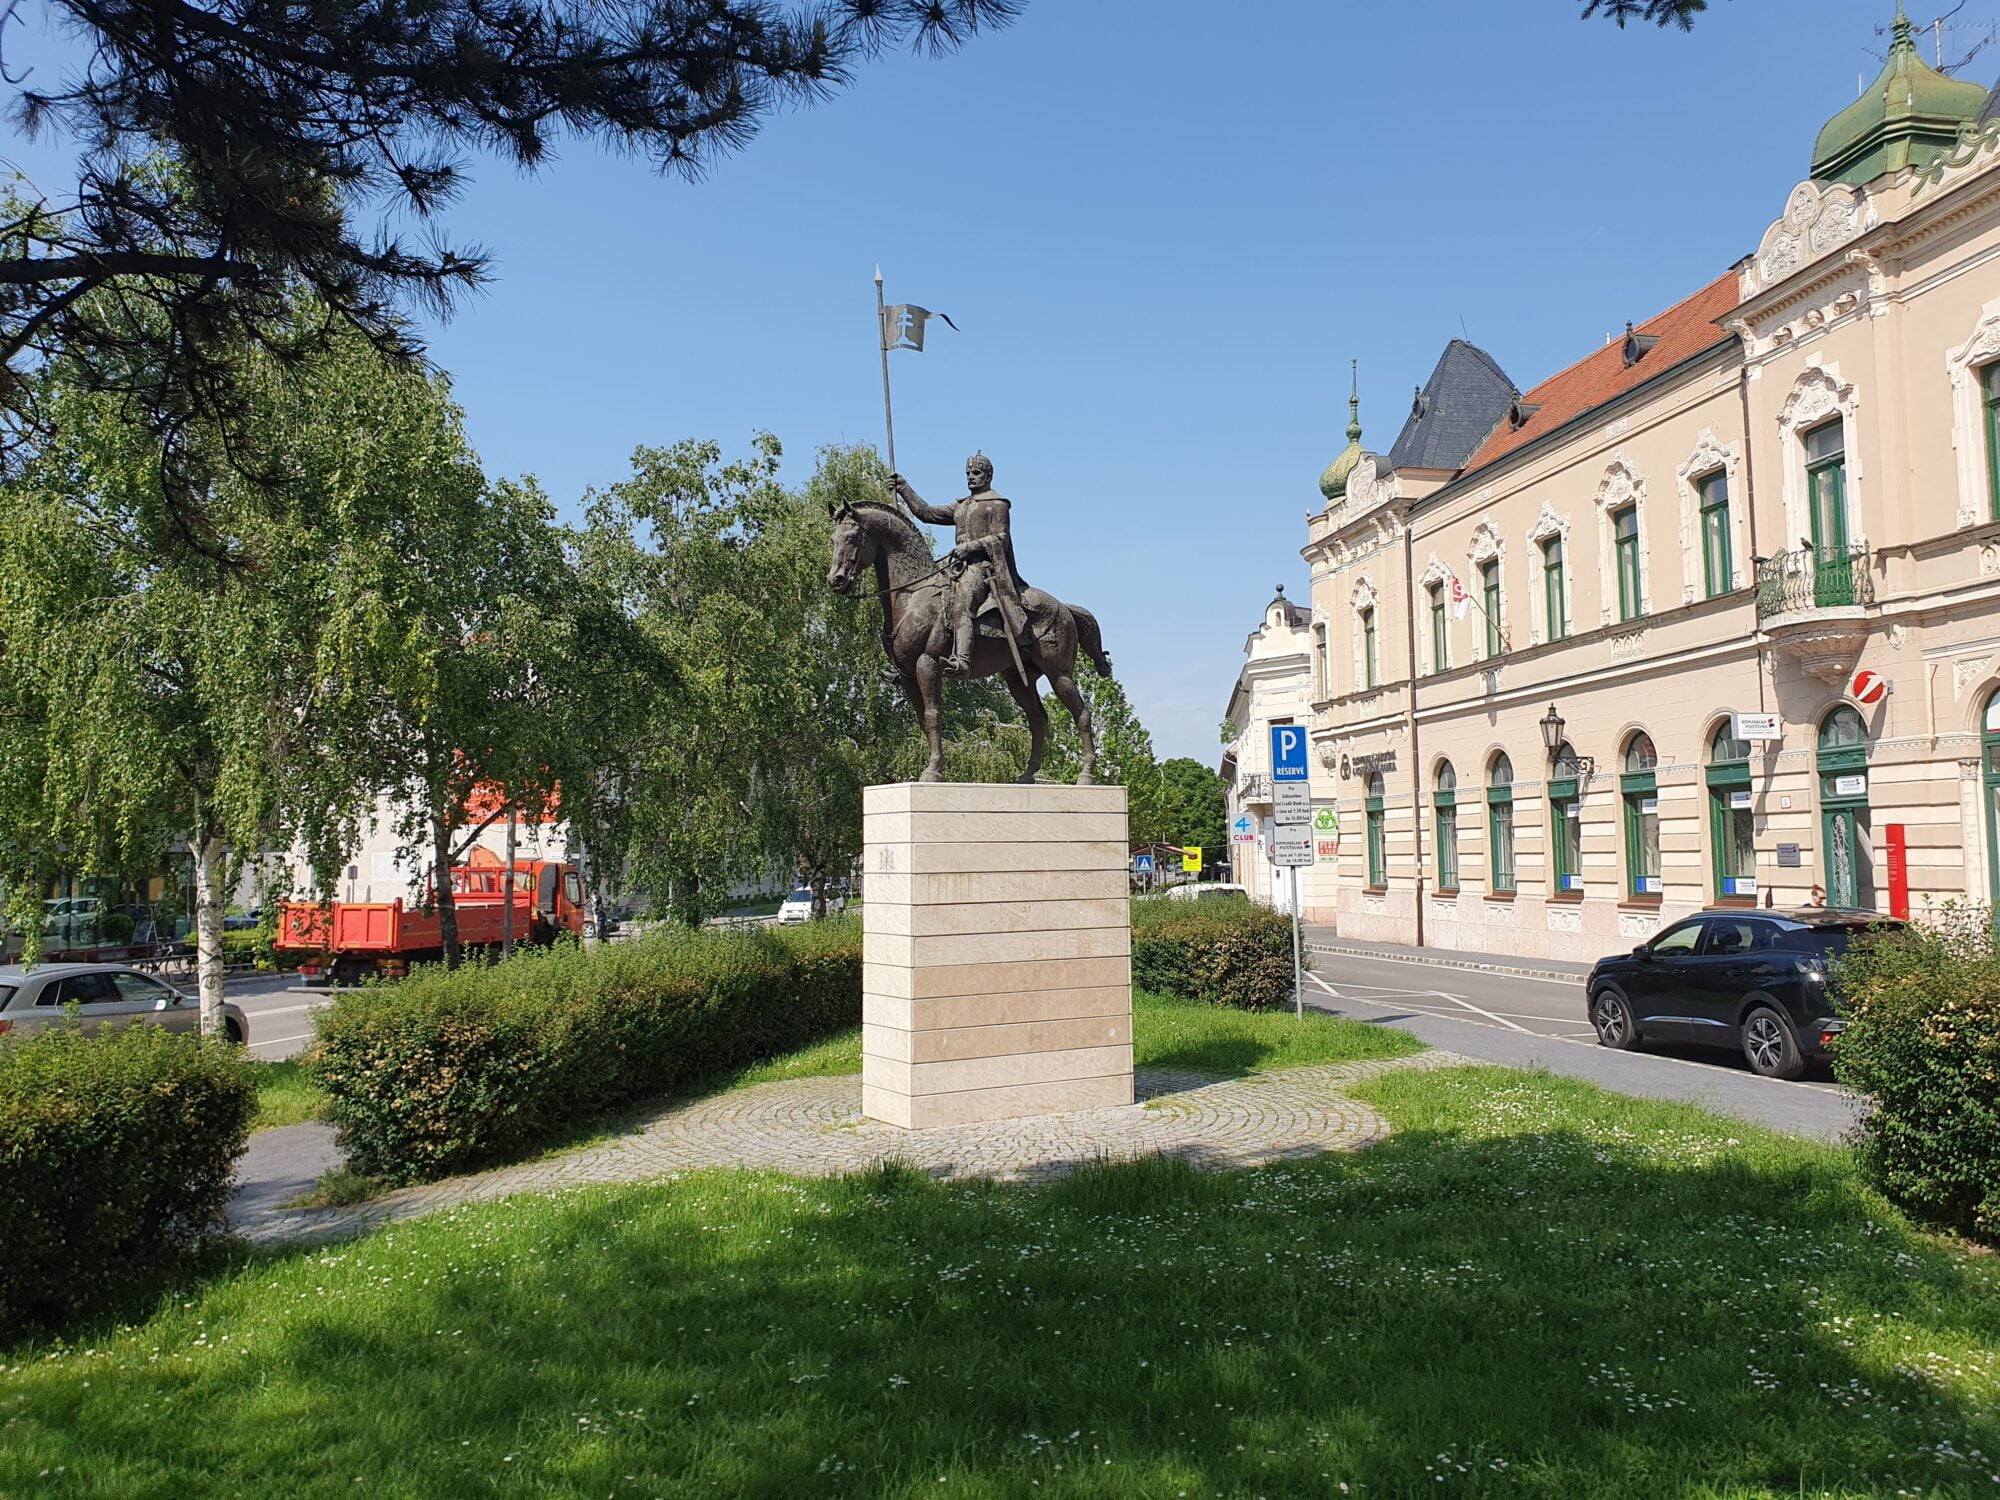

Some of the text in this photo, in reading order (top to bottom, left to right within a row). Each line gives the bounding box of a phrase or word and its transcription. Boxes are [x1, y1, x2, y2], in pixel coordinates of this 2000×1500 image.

[1280, 730, 1296, 760] P
[1276, 765, 1304, 776] RÉSERVÉ
[1235, 816, 1250, 832] 4
